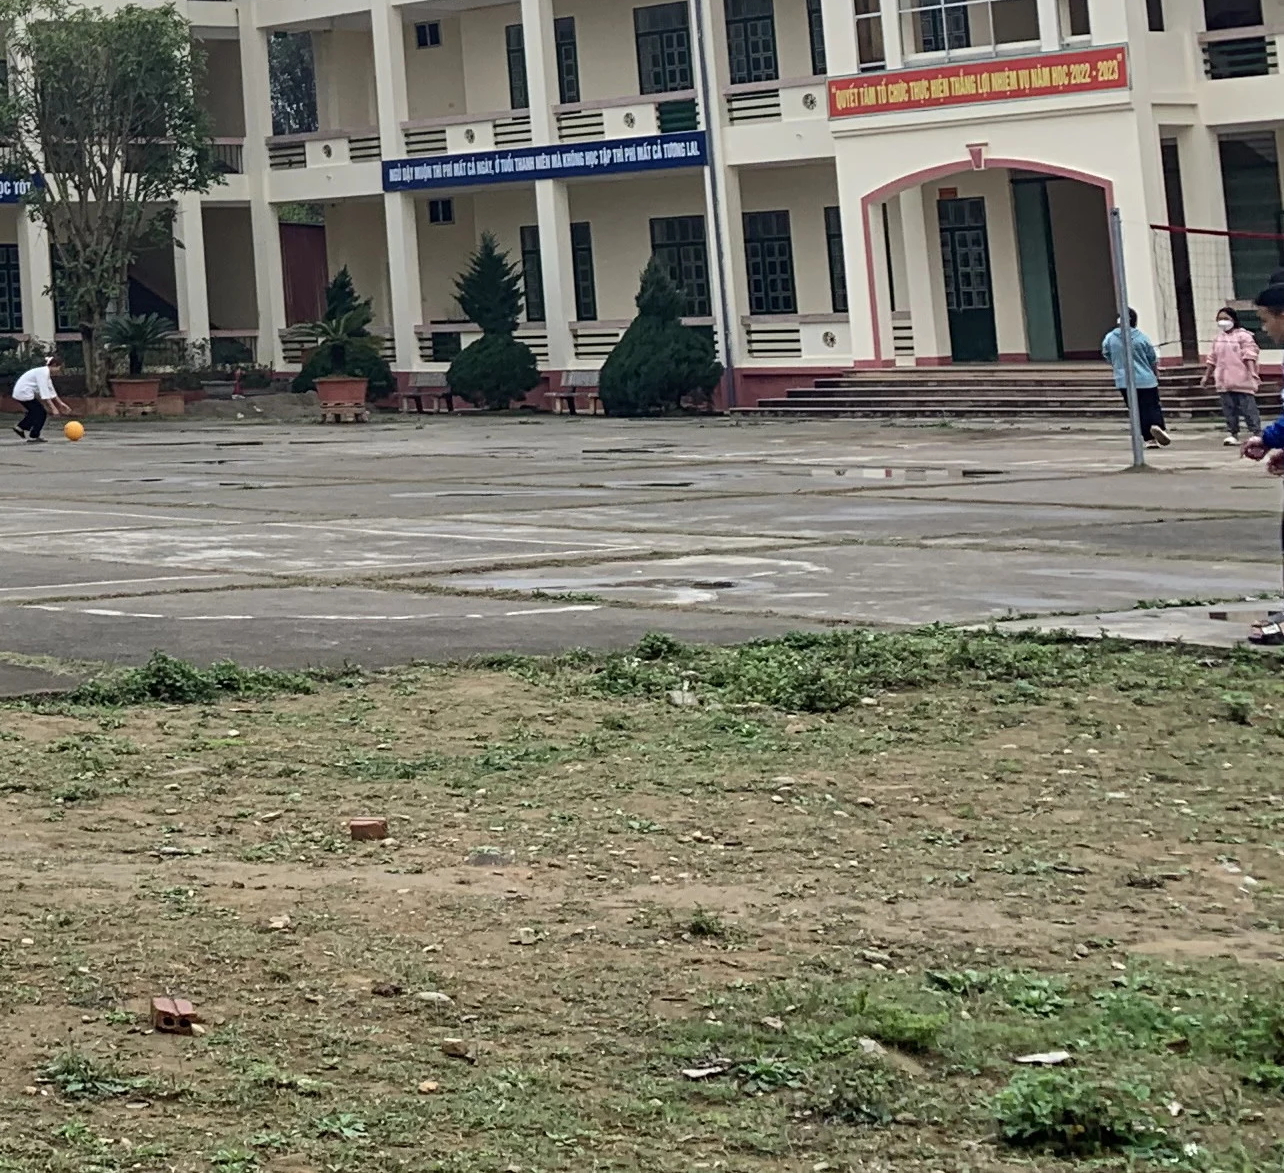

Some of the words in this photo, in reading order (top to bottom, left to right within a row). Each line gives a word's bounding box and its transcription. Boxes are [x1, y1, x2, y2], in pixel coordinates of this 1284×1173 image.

[909, 78, 930, 104] THỰC
[950, 68, 977, 96] THẮNG
[1052, 64, 1069, 90] HỌC
[1070, 62, 1092, 84] 2022
